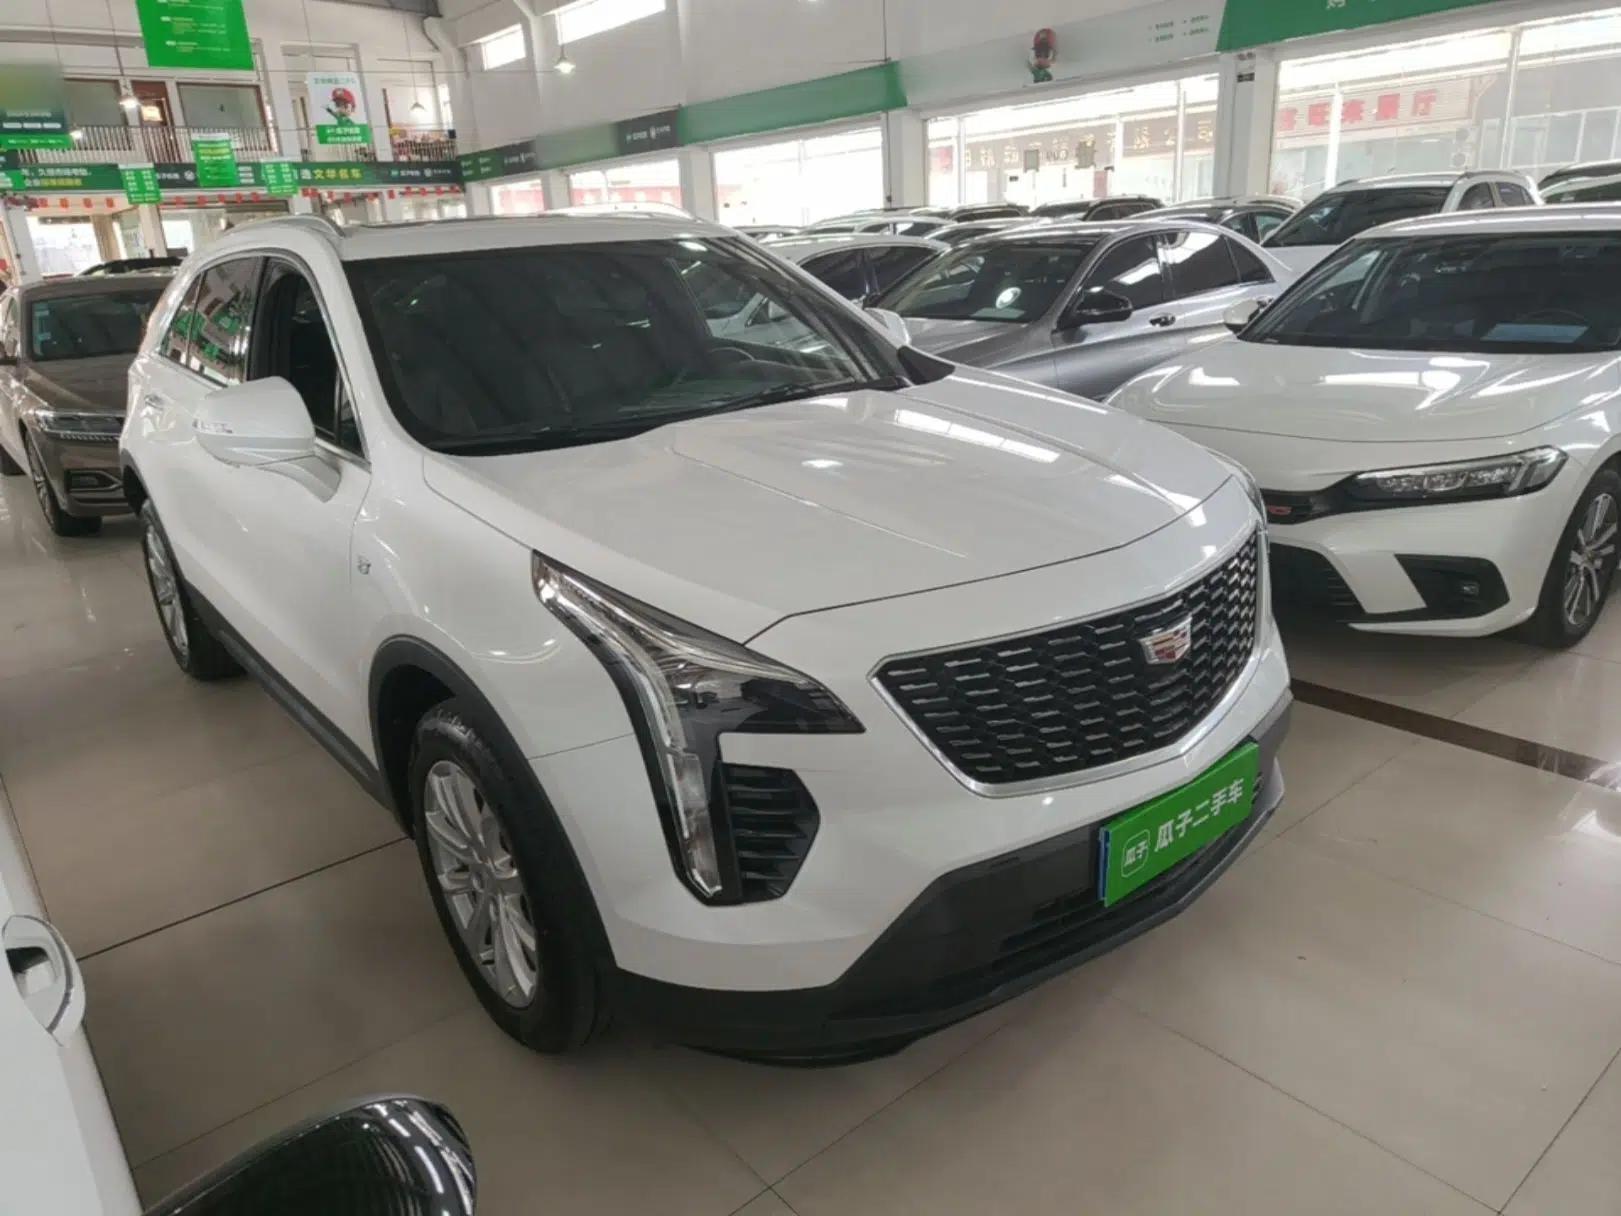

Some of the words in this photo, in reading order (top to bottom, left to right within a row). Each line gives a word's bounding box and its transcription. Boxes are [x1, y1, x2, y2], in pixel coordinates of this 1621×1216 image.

[1154, 778, 1244, 852] 瓜子二手车
[1124, 841, 1148, 867] 瓜子
